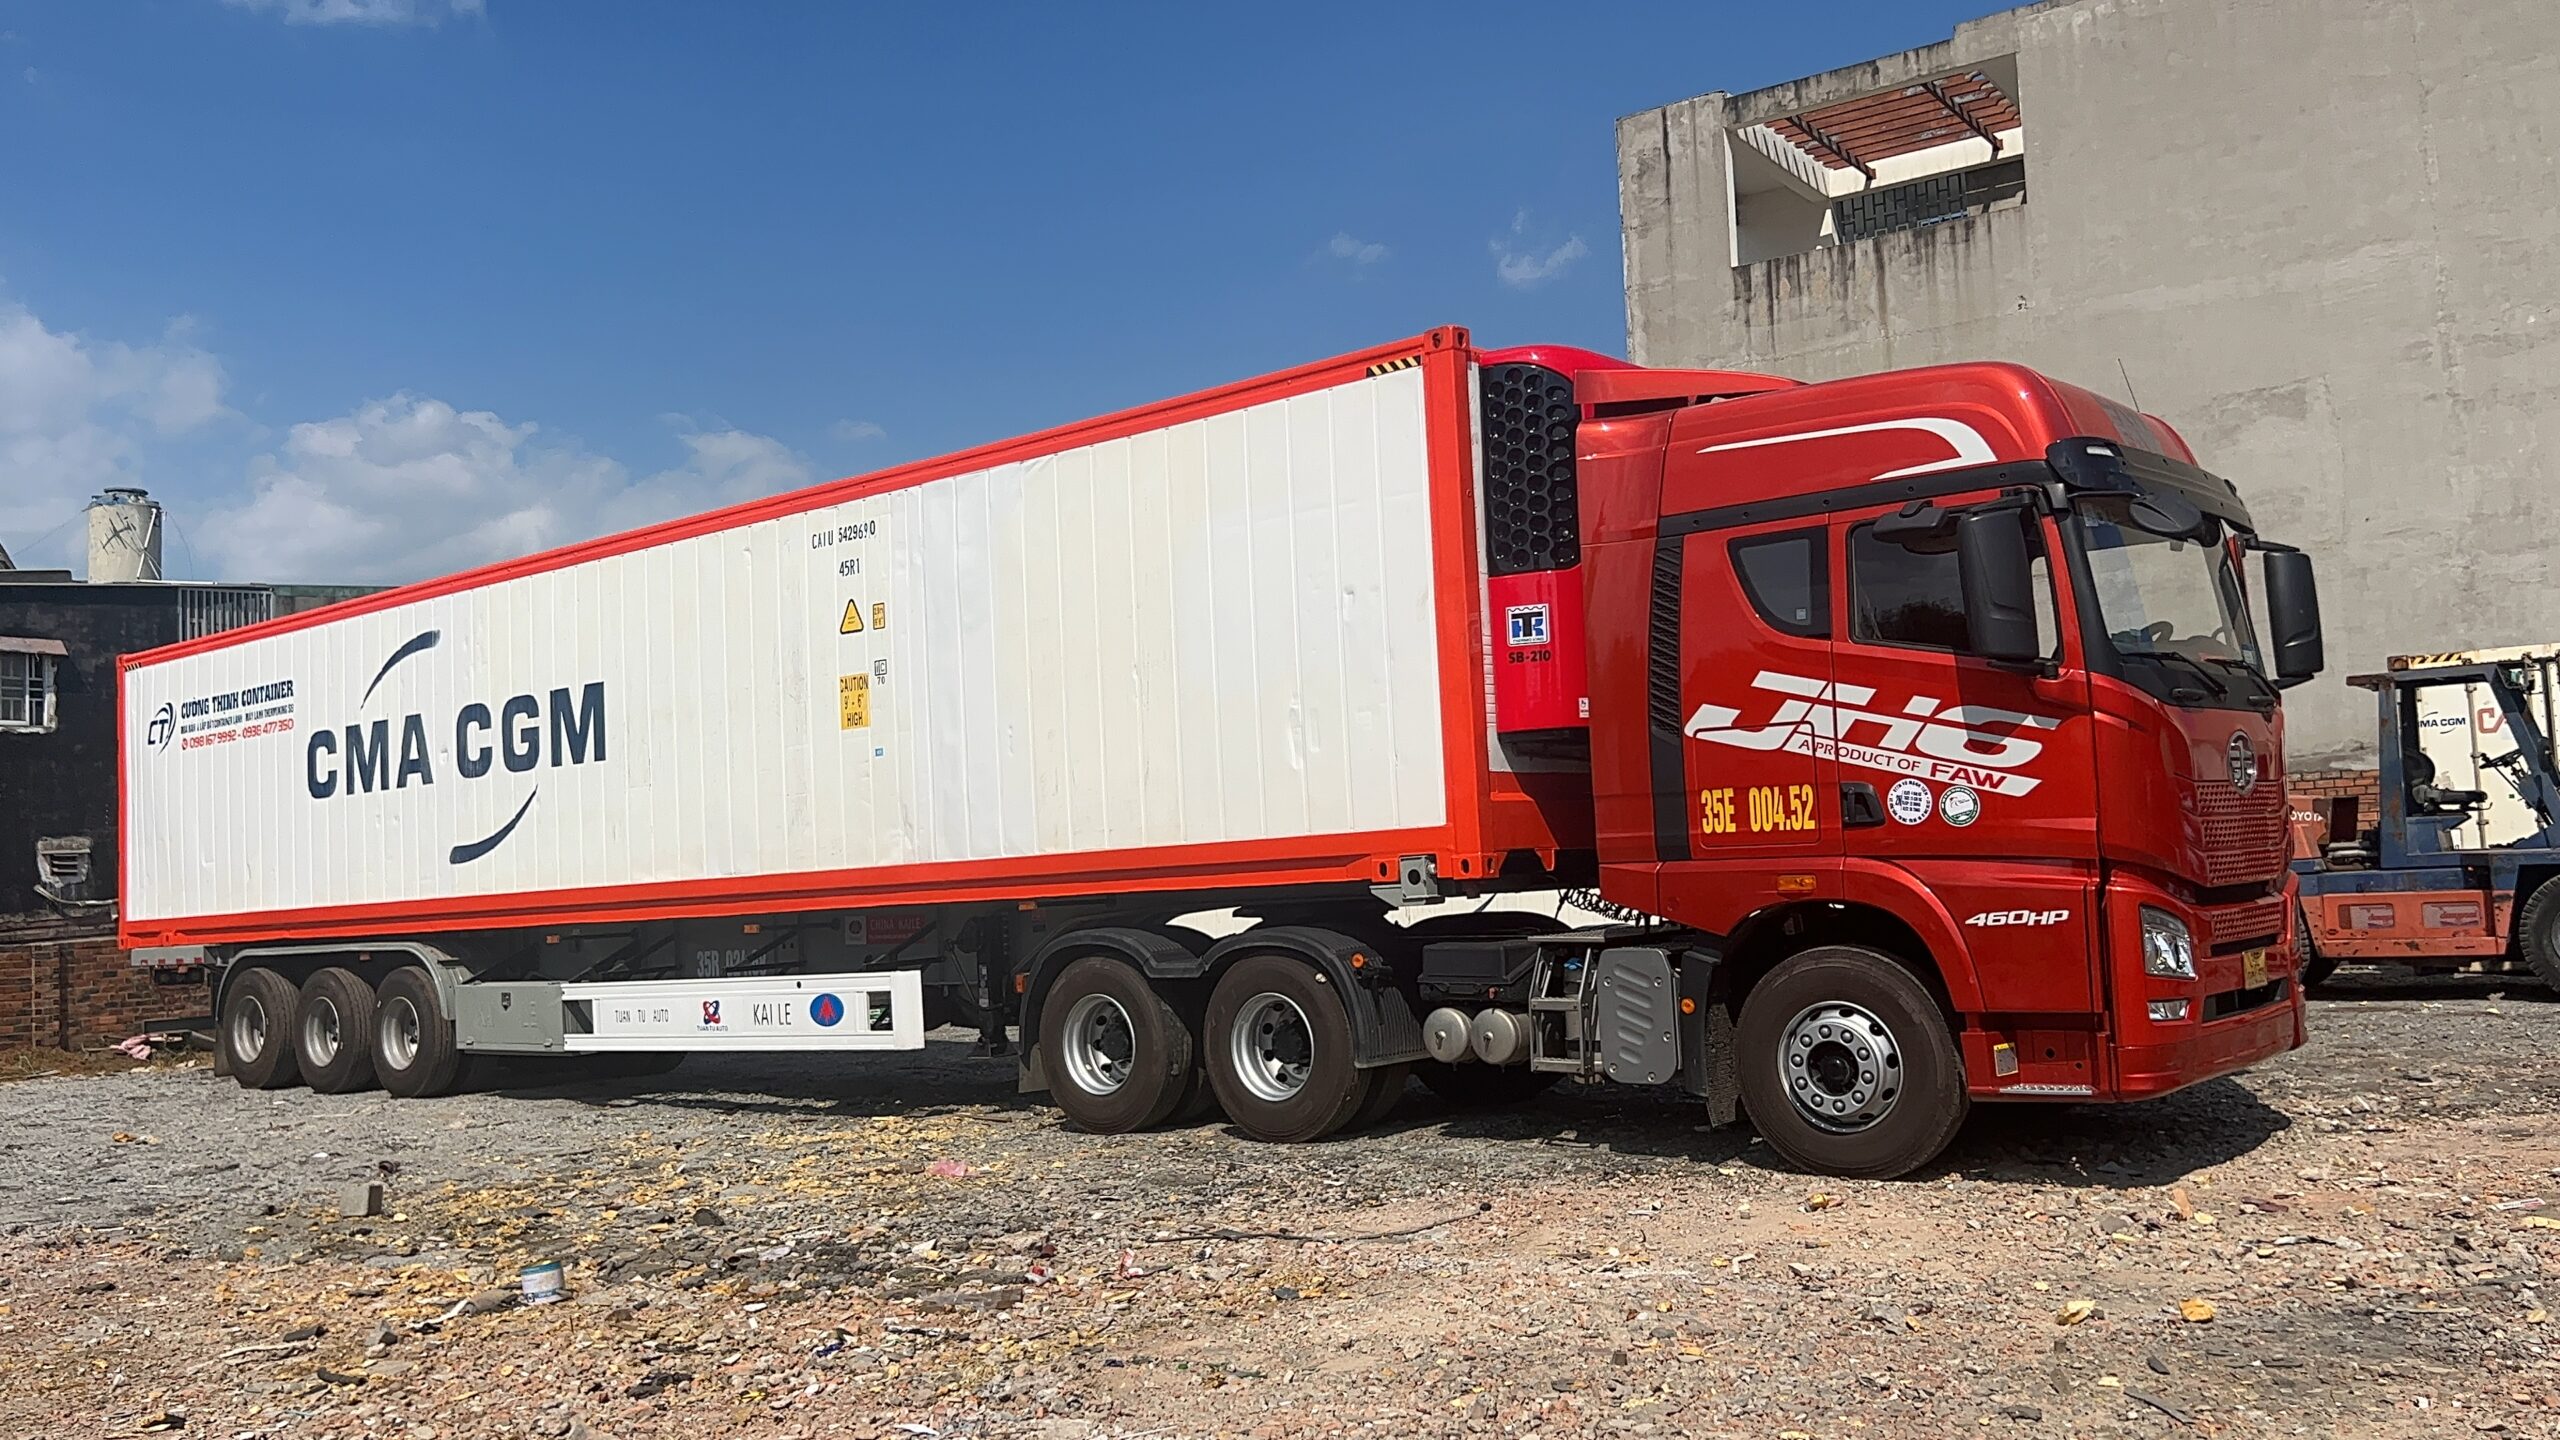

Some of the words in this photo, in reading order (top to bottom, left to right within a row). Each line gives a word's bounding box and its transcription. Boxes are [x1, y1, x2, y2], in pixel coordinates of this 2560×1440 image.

[811, 529, 834, 550] CAIU
[838, 557, 860, 577] 45R1
[840, 675, 869, 694] CAUTION
[212, 691, 239, 714] THỊNH
[242, 679, 294, 707] CONTAINER
[846, 710, 864, 727] HIGH
[2418, 719, 2439, 728] MA
[2440, 717, 2466, 727] CGM
[306, 713, 434, 799] CMA
[456, 681, 606, 779] CGM
[1798, 739, 1810, 751] A
[1814, 742, 1895, 767] PRODUCT
[1897, 758, 1921, 772] OF
[1930, 762, 2008, 790] FAW
[1700, 786, 1737, 834] 35E
[1749, 783, 1816, 832] 004.52
[1964, 909, 2070, 927] 460HP
[696, 950, 720, 977] 35R
[615, 1009, 631, 1023] TUAN
[637, 1009, 646, 1023] TU
[652, 1008, 669, 1023] AUTO
[753, 1003, 773, 1026] KAI
[778, 1002, 792, 1026] LE
